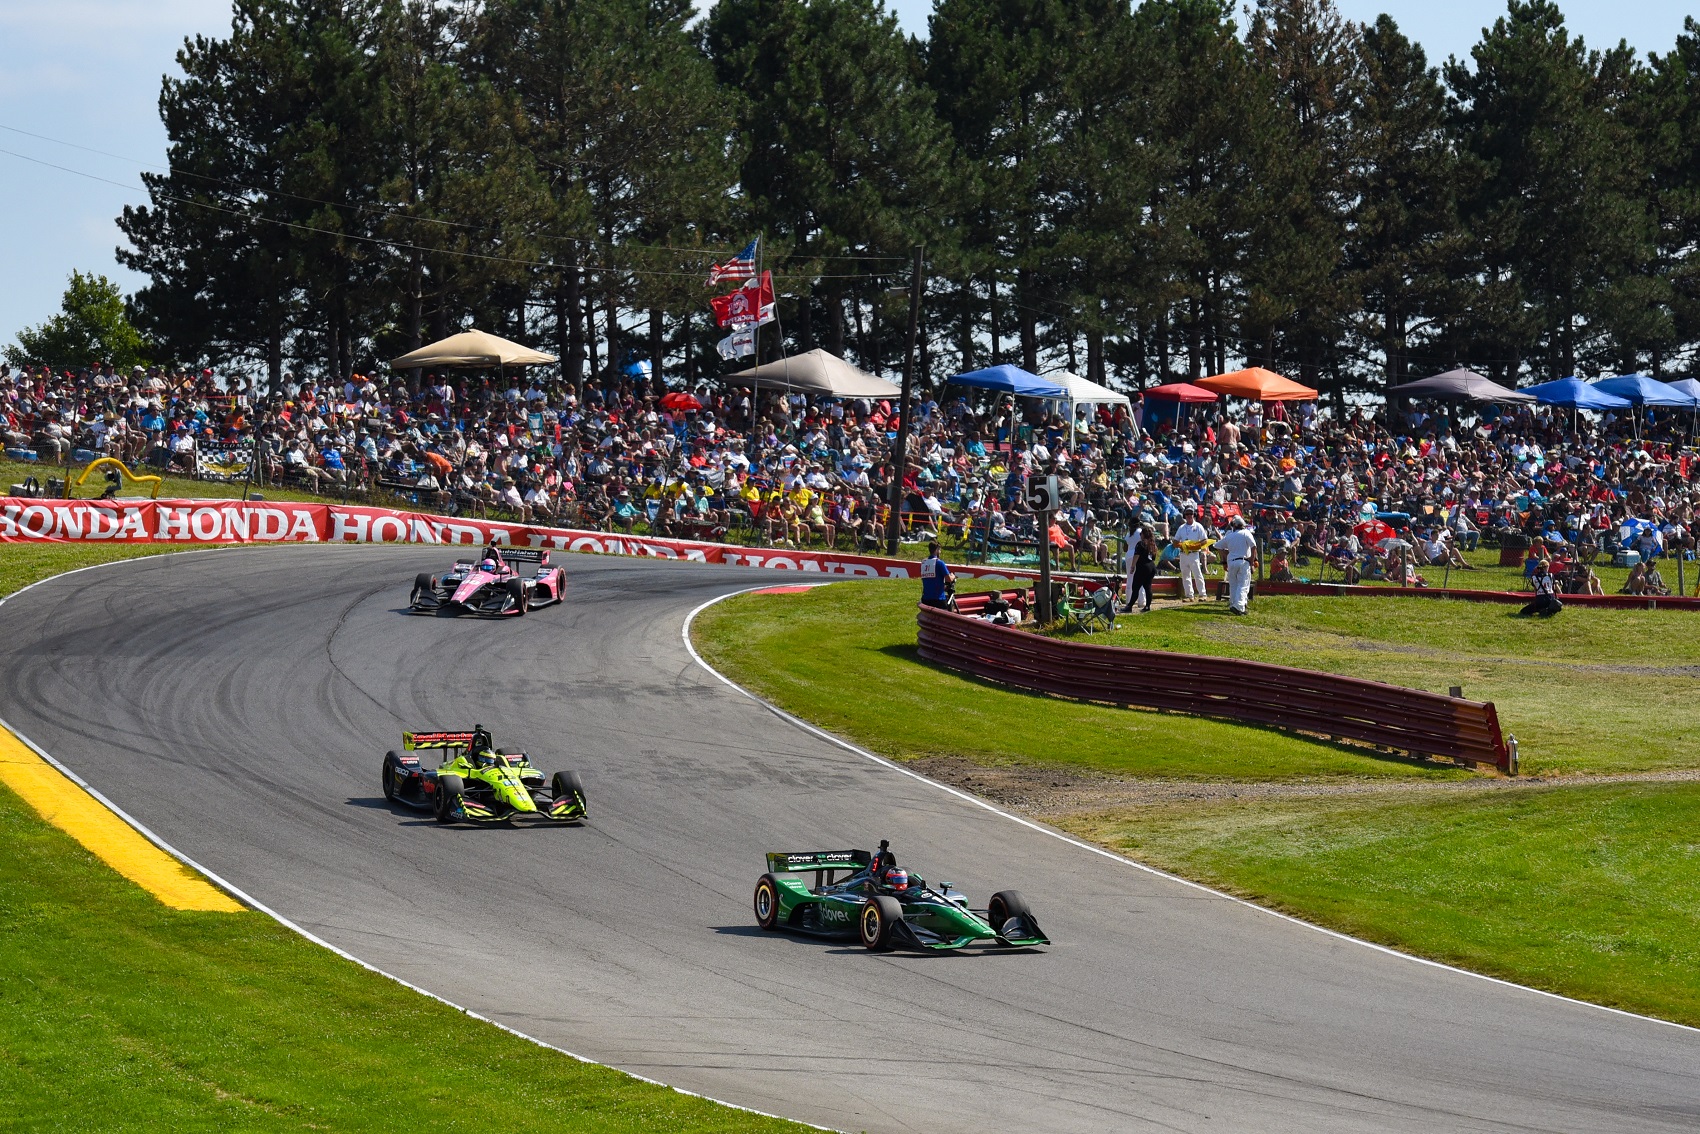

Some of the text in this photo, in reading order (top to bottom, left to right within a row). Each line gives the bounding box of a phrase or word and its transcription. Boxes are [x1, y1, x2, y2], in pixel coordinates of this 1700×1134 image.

[1027, 476, 1050, 511] 5
[153, 507, 320, 541] HONDA
[787, 852, 852, 863] clover clover
